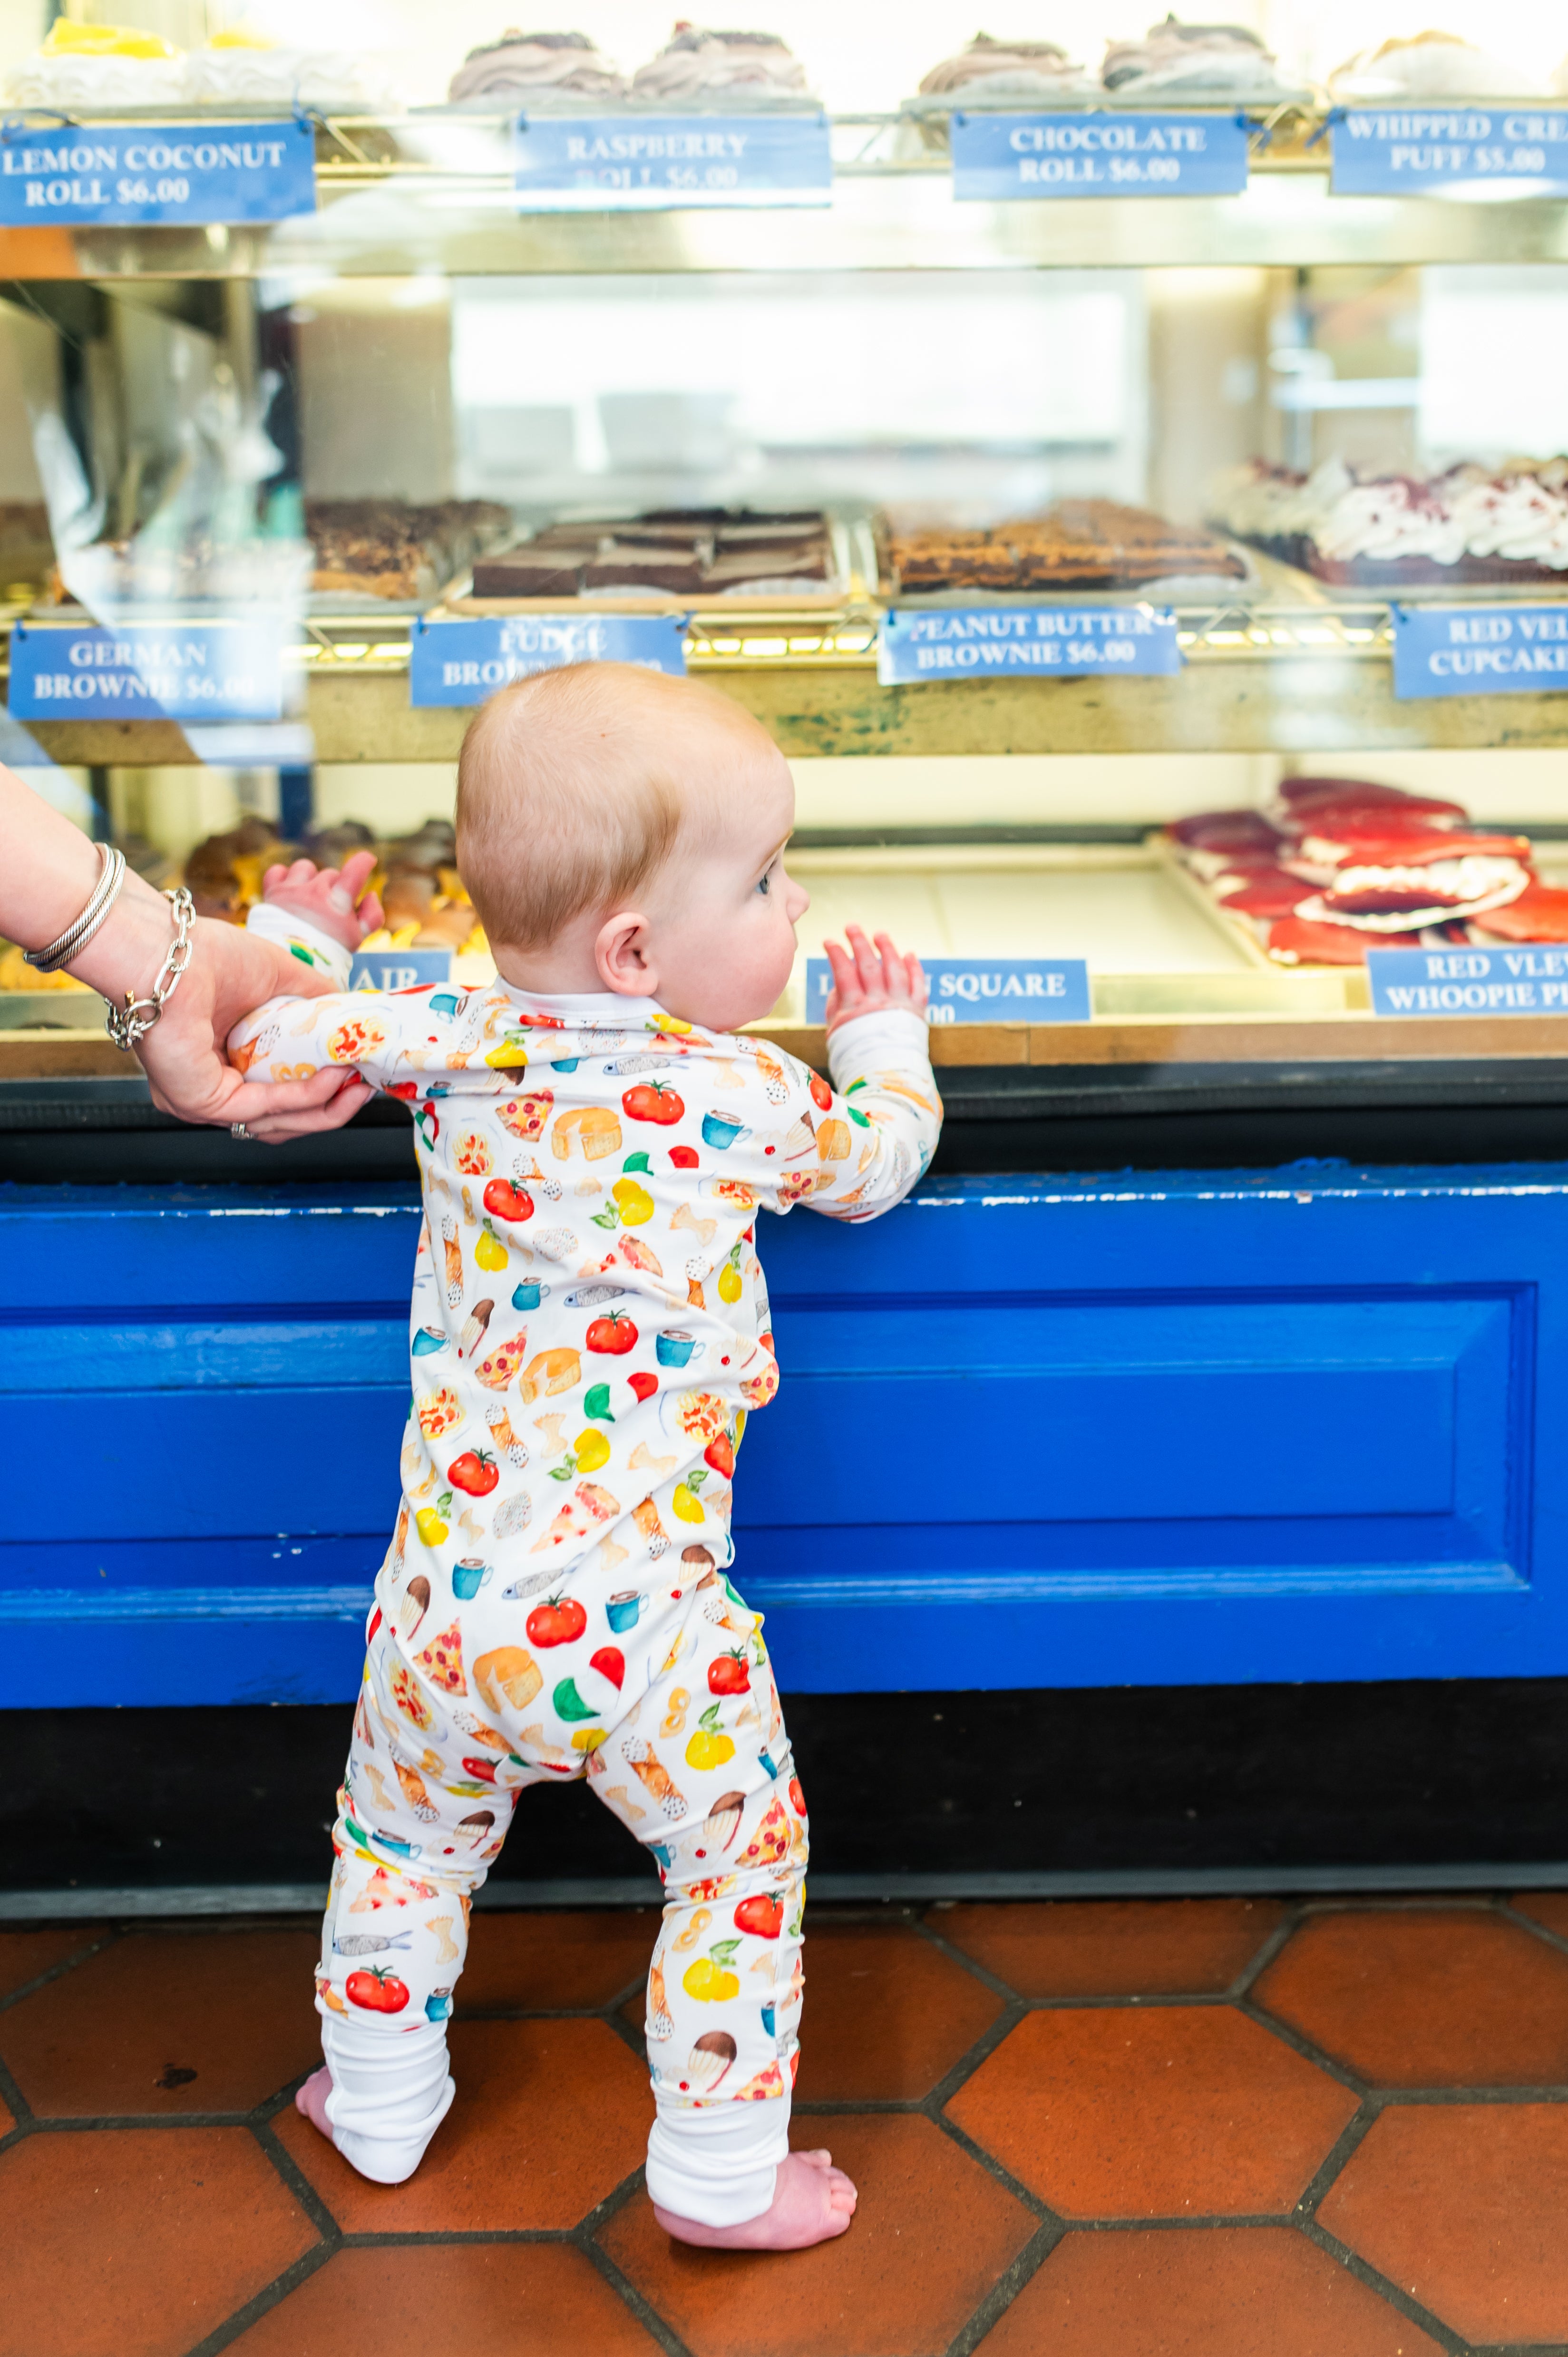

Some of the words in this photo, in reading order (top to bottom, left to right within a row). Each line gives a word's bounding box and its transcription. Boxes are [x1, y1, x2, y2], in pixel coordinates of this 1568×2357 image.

[1009, 126, 1208, 152] CHOCOLATE
[1346, 115, 1492, 140] WHIPPED
[1503, 115, 1568, 141] CRE
[2, 146, 117, 175] LEMON
[124, 142, 286, 171] COCONUT
[567, 134, 748, 160] RASPBERRY
[1391, 146, 1469, 171] PUFF
[1476, 146, 1546, 173] $5.00
[1019, 157, 1104, 183] ROLL
[1108, 156, 1180, 183] $6.00
[26, 179, 111, 207] ROLL
[117, 177, 190, 205] $6.00
[499, 625, 606, 653] FUDGE
[911, 614, 1029, 641] PEANUT
[1037, 610, 1154, 637] BUTTER
[1449, 615, 1513, 644] RED
[69, 640, 207, 667] GERMAN
[917, 642, 1062, 669] BROWNIE
[1067, 640, 1136, 663] $6.00
[34, 672, 180, 700] BROWNIE
[186, 674, 255, 699] $6.00
[352, 967, 418, 992] AIR
[1426, 955, 1491, 979] RED
[940, 974, 1066, 1001] SQUARE
[1386, 983, 1537, 1010] WHOOPIE
